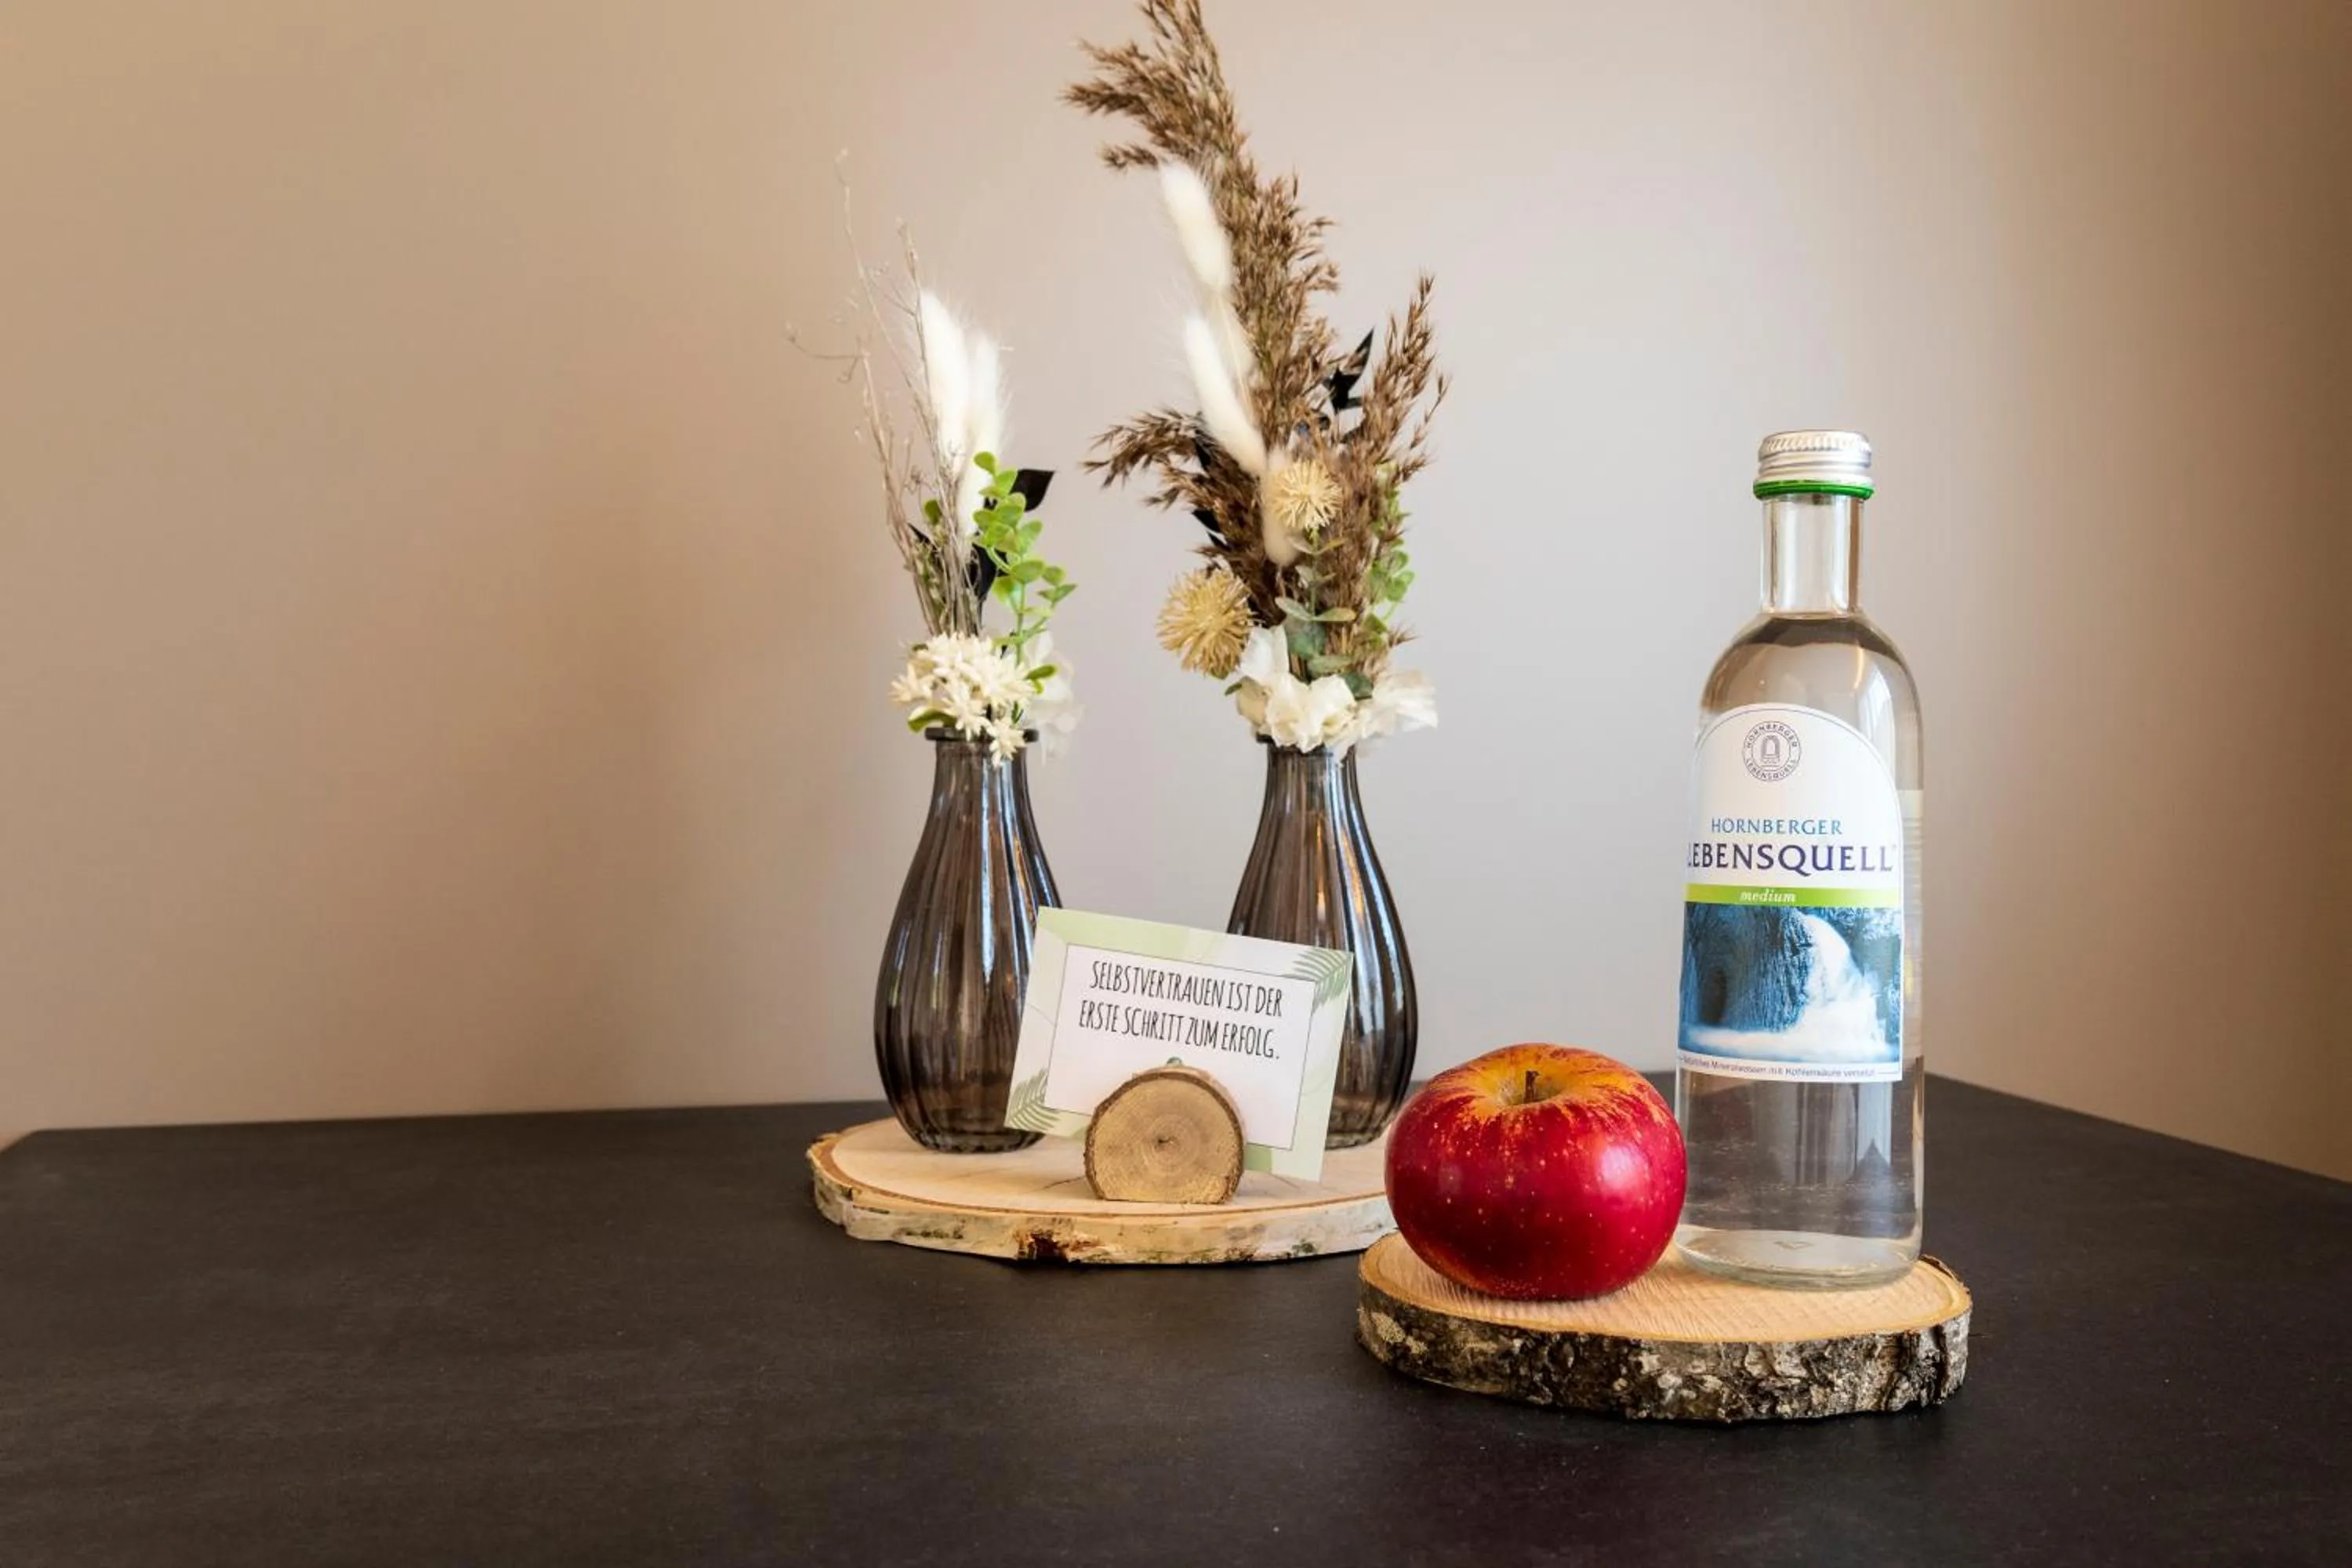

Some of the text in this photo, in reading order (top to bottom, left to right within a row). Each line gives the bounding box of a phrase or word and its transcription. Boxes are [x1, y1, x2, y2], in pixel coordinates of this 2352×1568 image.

[1711, 818, 1843, 835] HORNBERGER
[1740, 887, 1796, 902] medium
[1090, 960, 1283, 1017] SELBSTVERTRAUEN IST DER
[1079, 1000, 1279, 1059] ERSTE SCHRITT ZUM ERFOLG.
